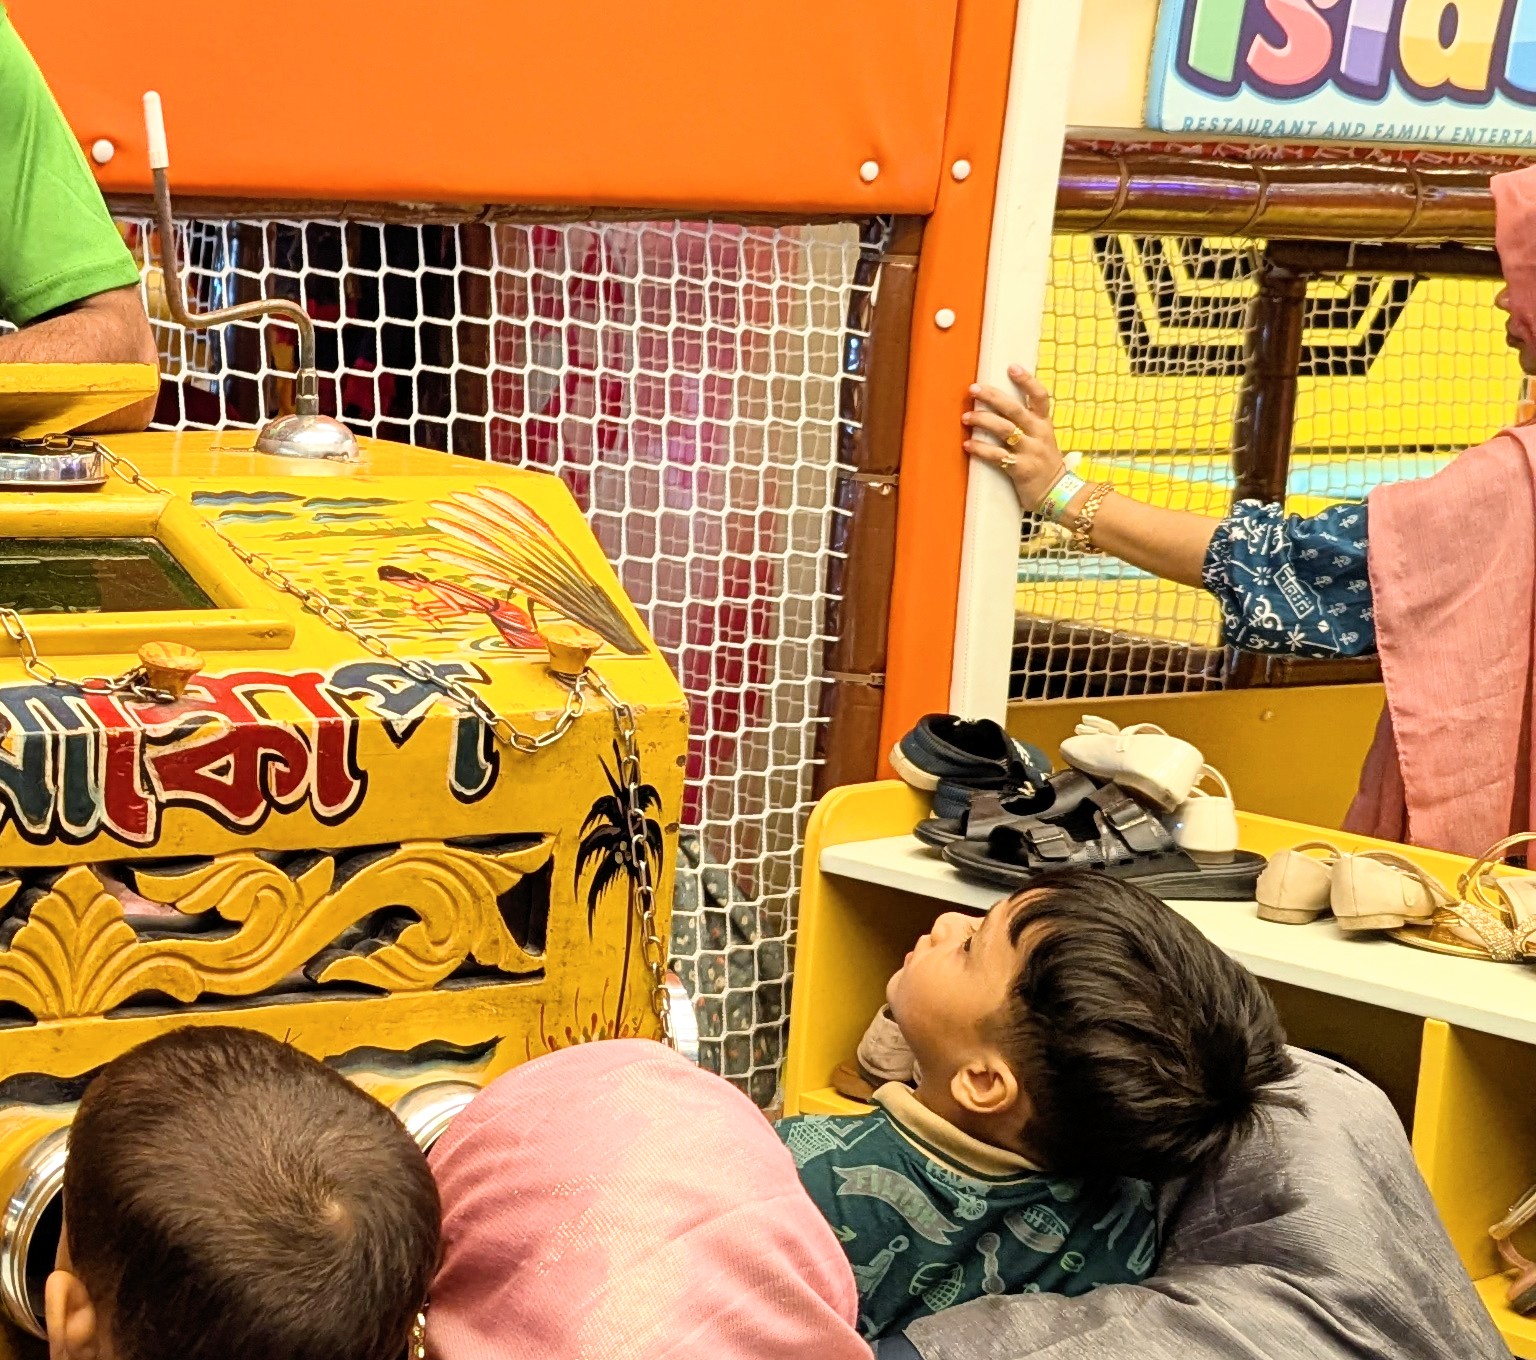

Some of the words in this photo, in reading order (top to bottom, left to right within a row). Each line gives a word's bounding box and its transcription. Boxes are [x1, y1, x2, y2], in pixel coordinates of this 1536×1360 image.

[1182, 116, 1317, 137] RESTAURANT
[1323, 121, 1366, 139] AND
[1372, 123, 1445, 141] FAMILY
